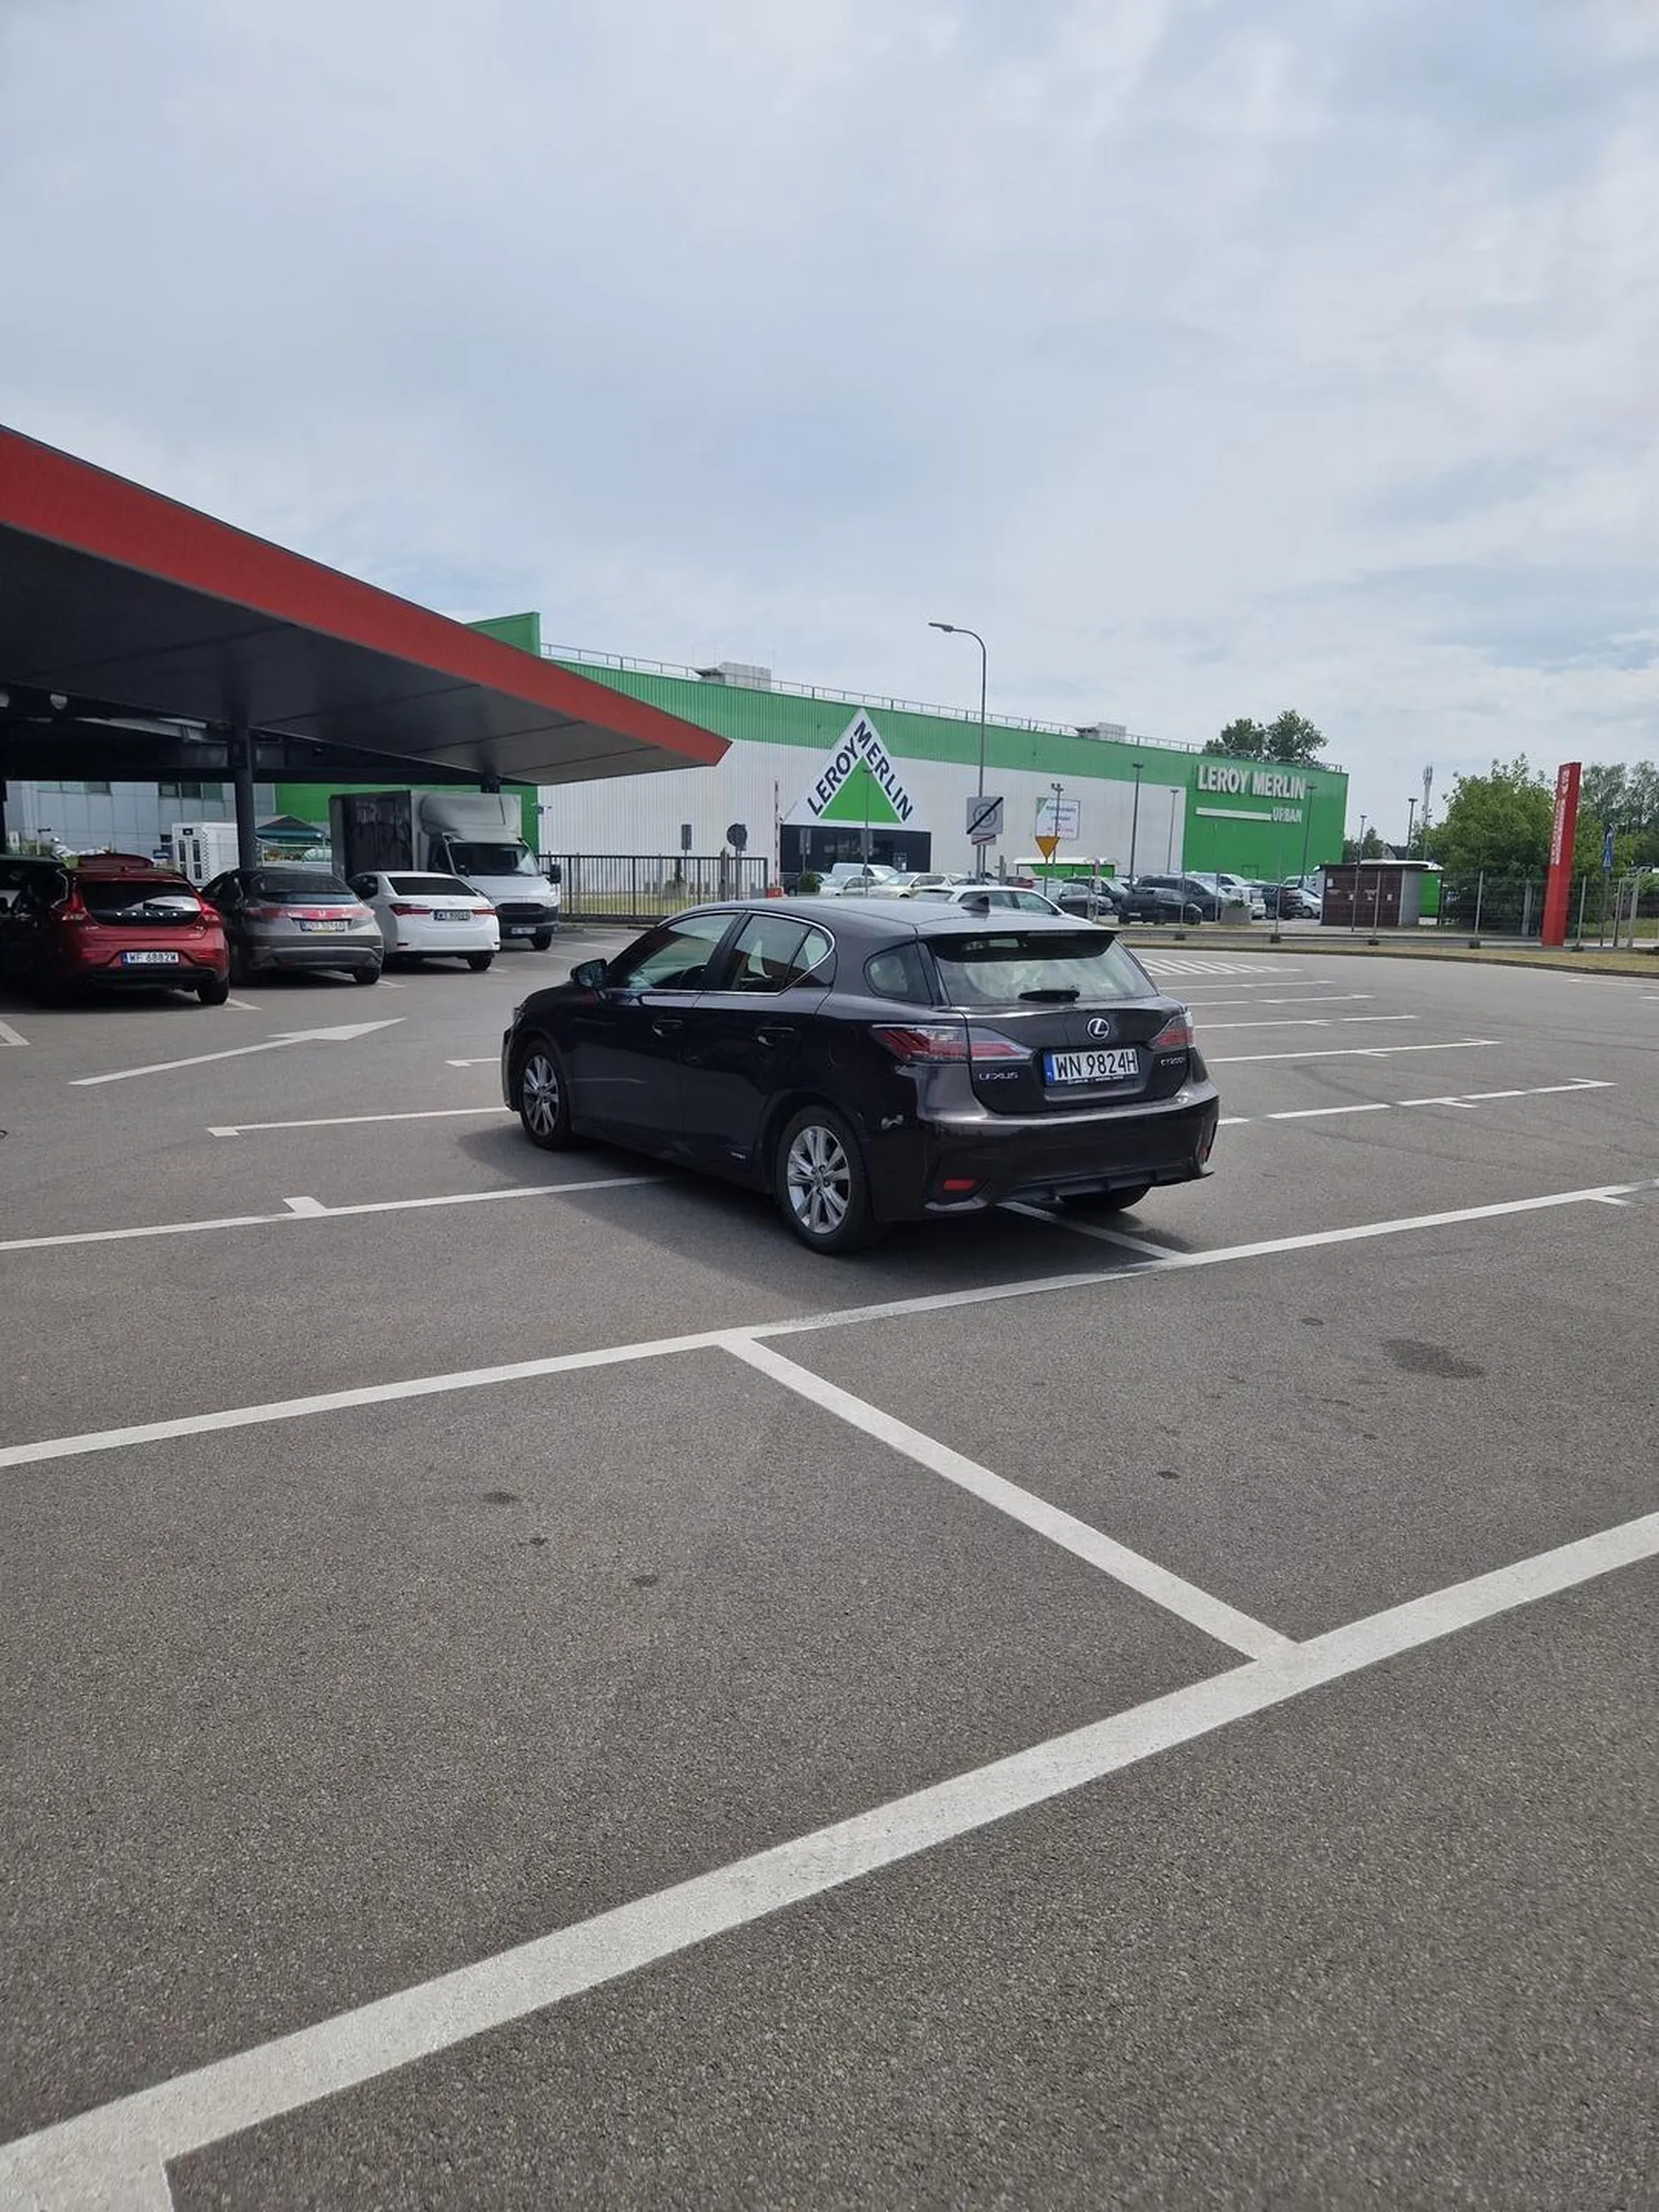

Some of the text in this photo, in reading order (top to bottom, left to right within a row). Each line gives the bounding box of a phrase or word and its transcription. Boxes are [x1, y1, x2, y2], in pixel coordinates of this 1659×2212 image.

[807, 719, 914, 821] LEROY MERLIN
[1198, 764, 1306, 799] LEROY MERLIN
[1271, 807, 1302, 824] URBAN
[1056, 1050, 1137, 1078] WN 9824H
